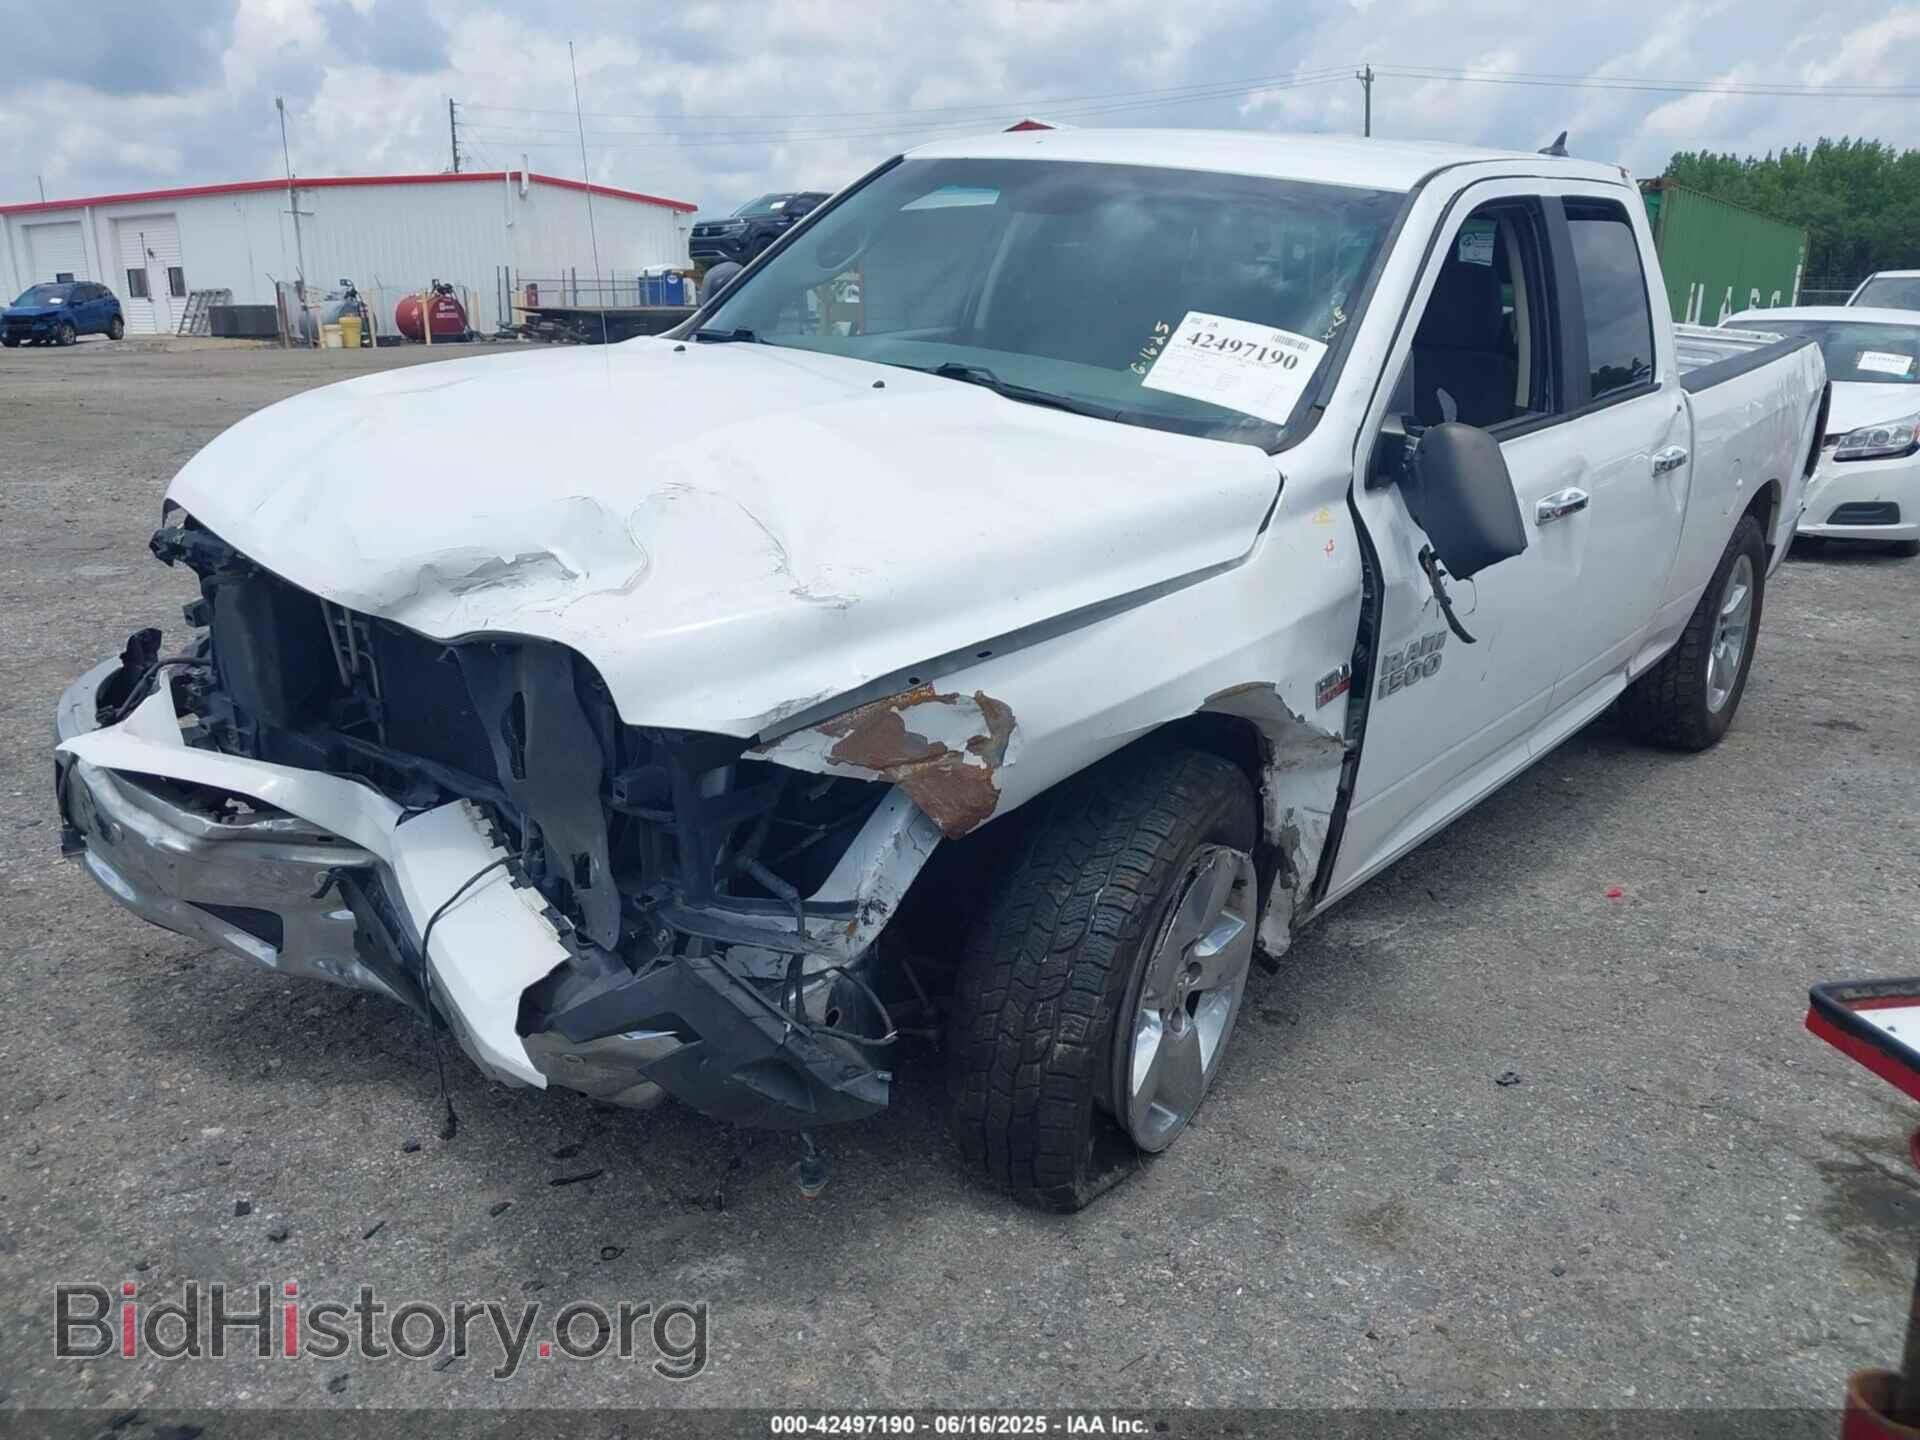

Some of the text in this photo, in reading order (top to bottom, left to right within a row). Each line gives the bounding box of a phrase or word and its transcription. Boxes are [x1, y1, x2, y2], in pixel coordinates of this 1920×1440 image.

[1186, 331, 1298, 370] 42497190
[1381, 631, 1446, 675] RAM
[1377, 652, 1442, 700] 1500
